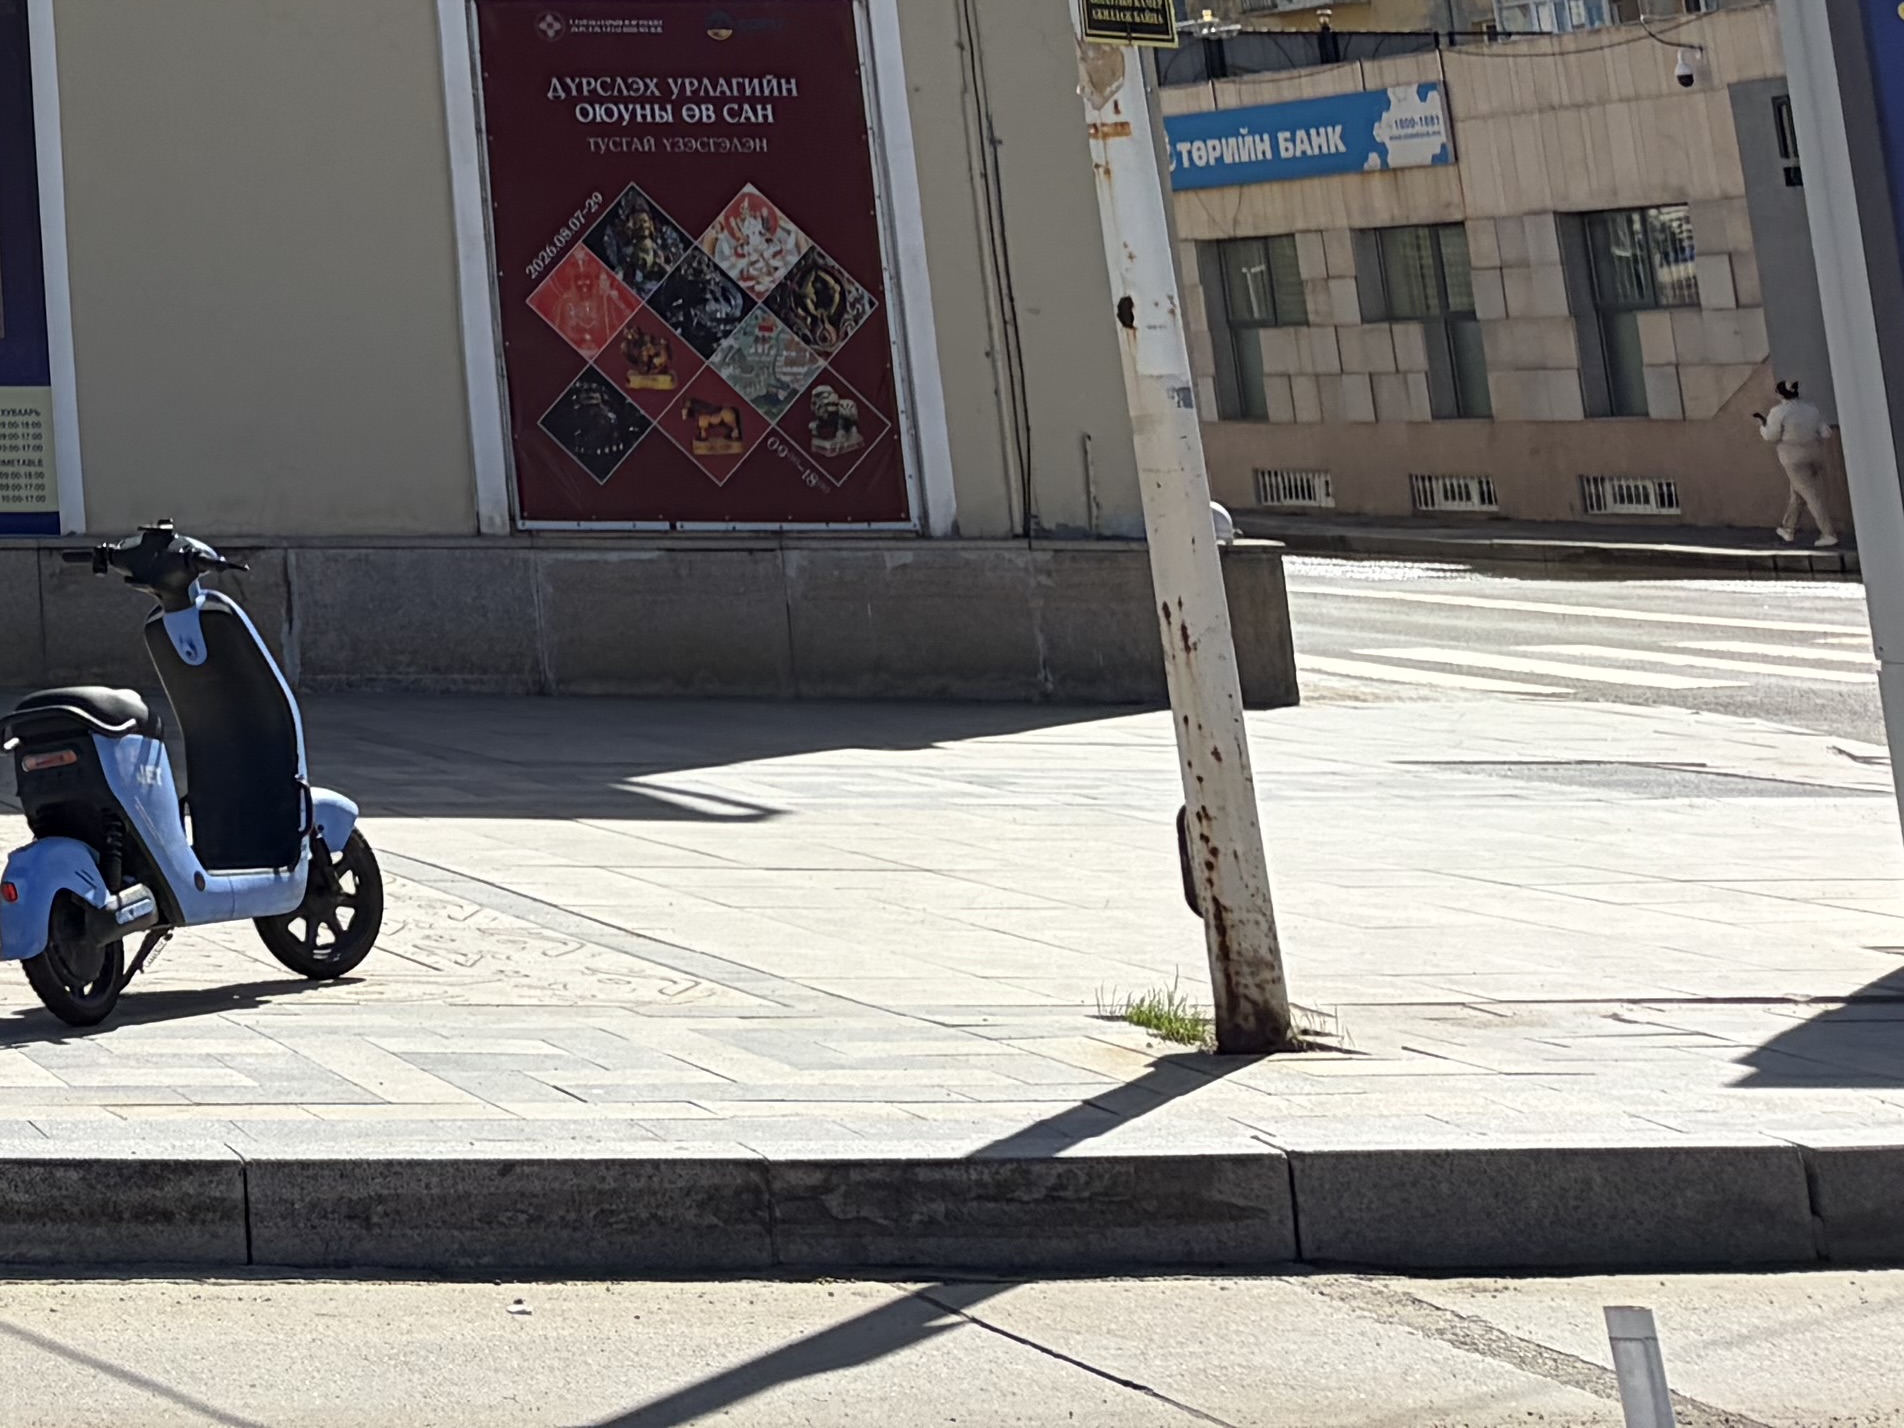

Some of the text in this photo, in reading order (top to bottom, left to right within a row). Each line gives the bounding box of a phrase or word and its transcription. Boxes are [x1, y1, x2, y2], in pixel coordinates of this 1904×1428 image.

[547, 75, 799, 101] ДҮРСЛЭХ УРЛАГИЙН
[575, 103, 774, 126] ОЮУНЫ ӨВ САН
[588, 136, 769, 155] ТУСГАЙ ҮЗЭСГЭЛЭН
[1176, 124, 1347, 169] ТӨРИЙН БАНК
